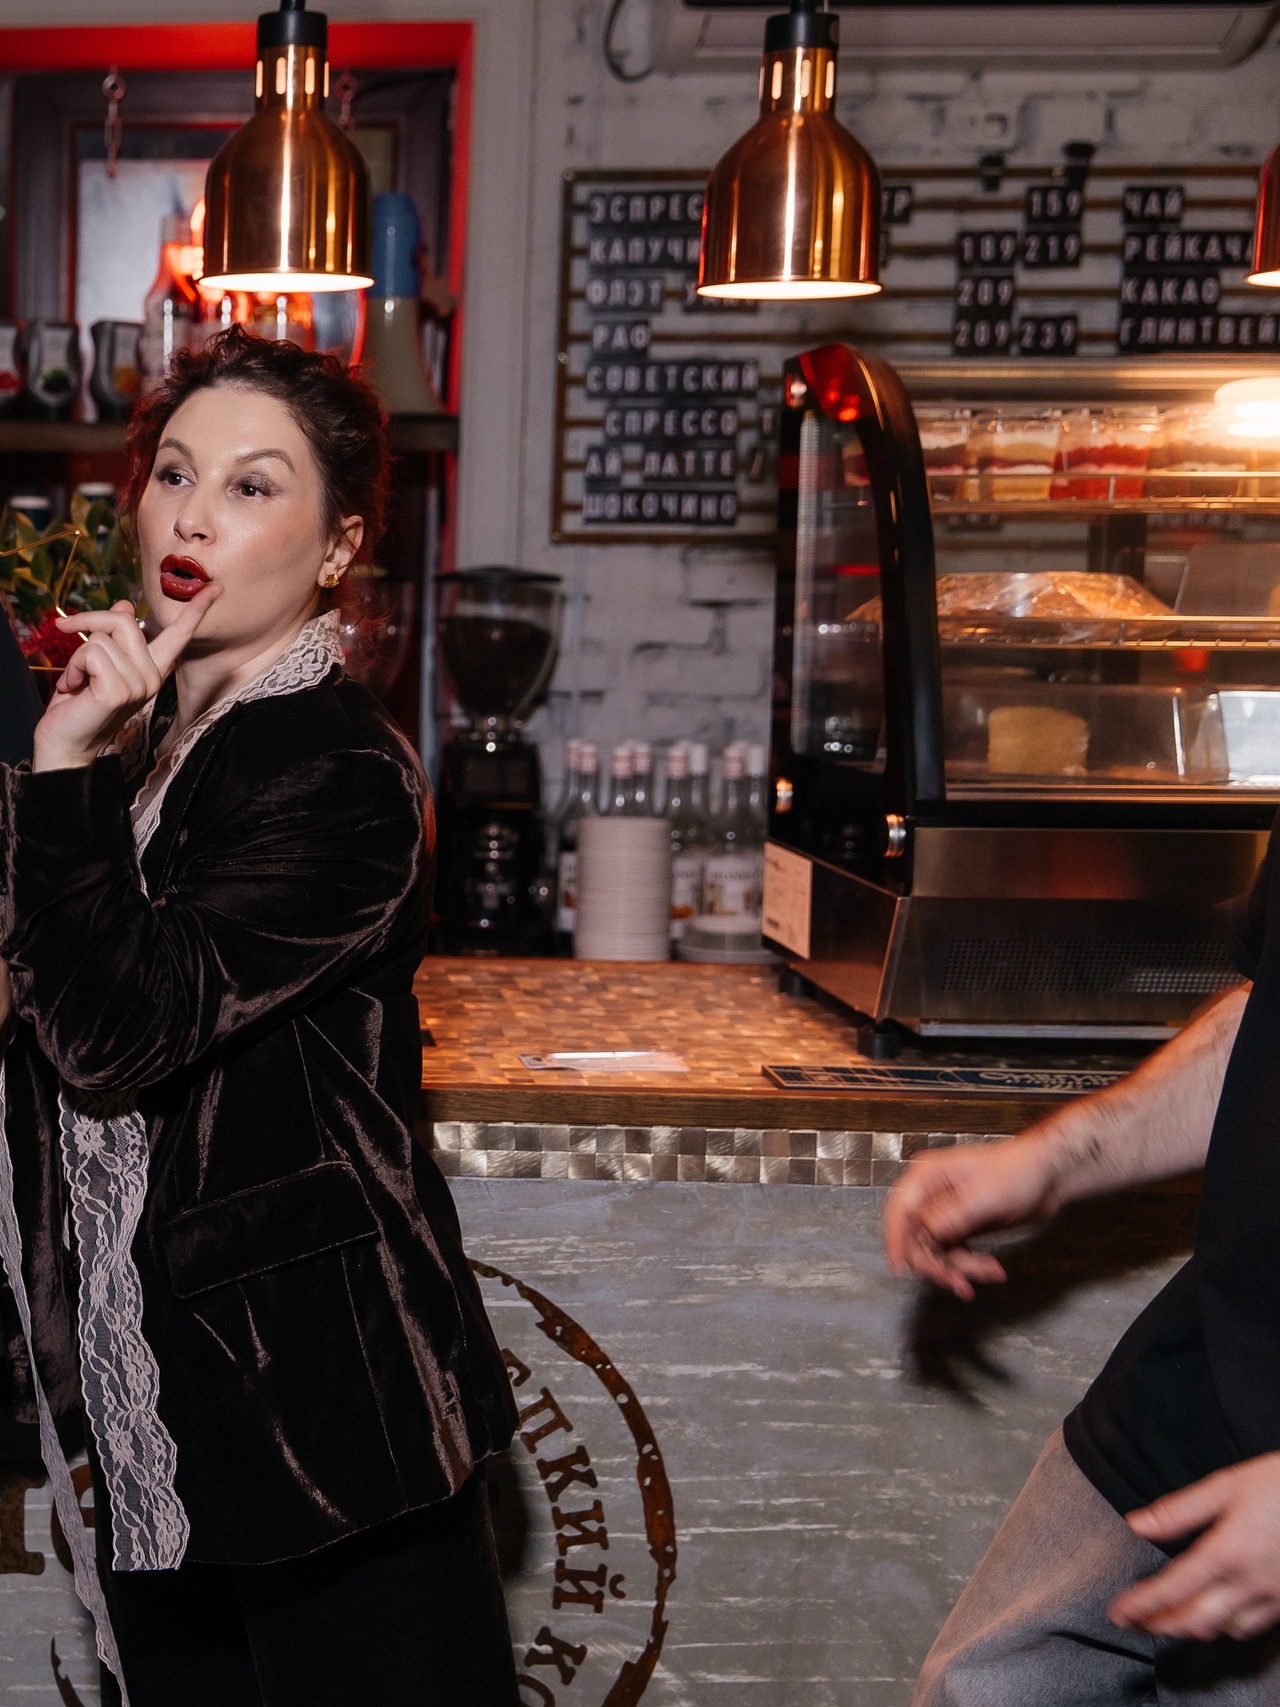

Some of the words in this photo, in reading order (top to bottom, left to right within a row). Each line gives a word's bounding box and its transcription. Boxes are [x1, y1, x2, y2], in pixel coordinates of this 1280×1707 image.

[589, 194, 704, 223] ЭСПРЕС
[1124, 187, 1183, 219] ЧАЙ
[589, 236, 703, 264] КАПУЧИ
[1025, 234, 1080, 263] 219
[957, 278, 1014, 307] 209
[1121, 276, 1219, 305] КАКАО
[955, 318, 1011, 347] 209
[1120, 315, 1280, 346] ГЛИНТВЕЙ
[586, 362, 759, 393] СОВЕТСКИЙ
[605, 409, 738, 436] СПРЕССО
[644, 451, 732, 477] ЛАТТЕ
[582, 491, 738, 521] ШОКОЧИНО
